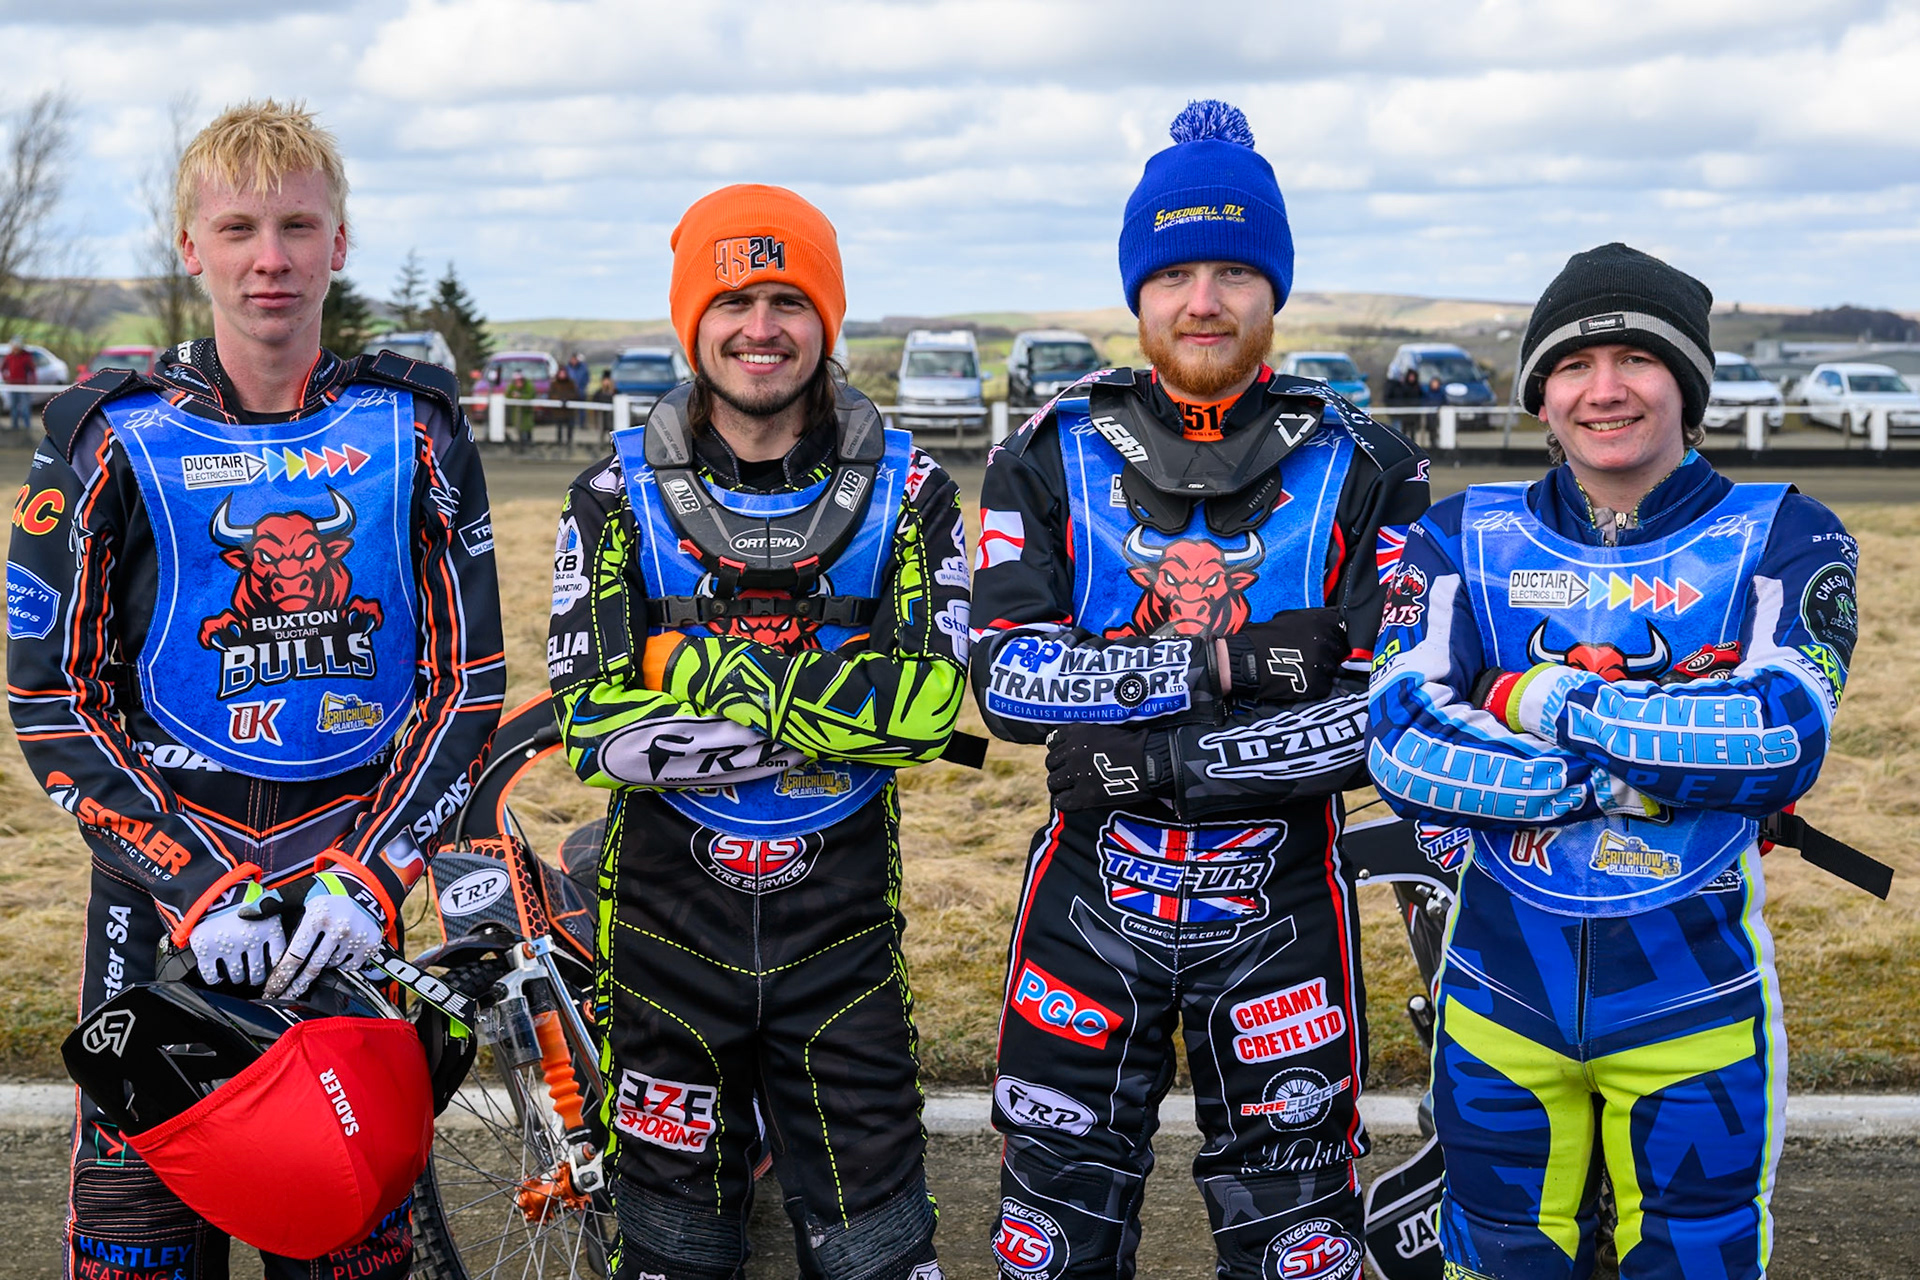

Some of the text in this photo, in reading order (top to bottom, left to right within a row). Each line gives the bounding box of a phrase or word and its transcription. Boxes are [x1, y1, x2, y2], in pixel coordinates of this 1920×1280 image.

[183, 456, 243, 471] DUCTAIR
[186, 470, 228, 482] ELECTRICS
[735, 537, 800, 549] ORTEMA
[1511, 572, 1568, 589] DUCTAIR
[1511, 590, 1550, 599] ELECTRICS
[1816, 575, 1849, 601] CHESIL
[8, 595, 25, 604] of
[252, 609, 338, 632] BUXTON
[275, 627, 319, 640] DUCTAIR
[220, 633, 376, 698] BULLS
[999, 639, 1187, 673] P&P MATHER
[993, 667, 1185, 708] TRANSPORT LTD
[327, 705, 373, 723] CRITCHLOW
[994, 699, 1057, 718] SPECIALIST
[1063, 707, 1131, 718] MACHINERY
[1594, 687, 1757, 728] OLIVER
[333, 720, 355, 733] PLANT
[1569, 705, 1798, 766] WITHERS
[1394, 731, 1564, 791] OLIVER
[786, 774, 835, 789] CRITCHLOW
[792, 785, 825, 796] PLANT LTD
[1369, 741, 1584, 818] WITHERS
[413, 772, 472, 844] SIGNS
[76, 796, 192, 876] SADLER
[714, 835, 798, 861] STS
[1602, 850, 1663, 867] CRITCHLOW
[1609, 865, 1649, 875] PLANT LTD
[708, 859, 807, 890] TYRE SERVICES
[106, 905, 131, 944] SA
[1236, 982, 1323, 1030] CREAMY
[1238, 1010, 1342, 1060] CRETE LTD
[319, 1067, 360, 1137] SADLER
[620, 1110, 708, 1148] SHORING
[80, 1235, 193, 1268] HARTLEY
[1272, 1221, 1331, 1255] STAKEFORD
[1283, 1237, 1345, 1278] STS
